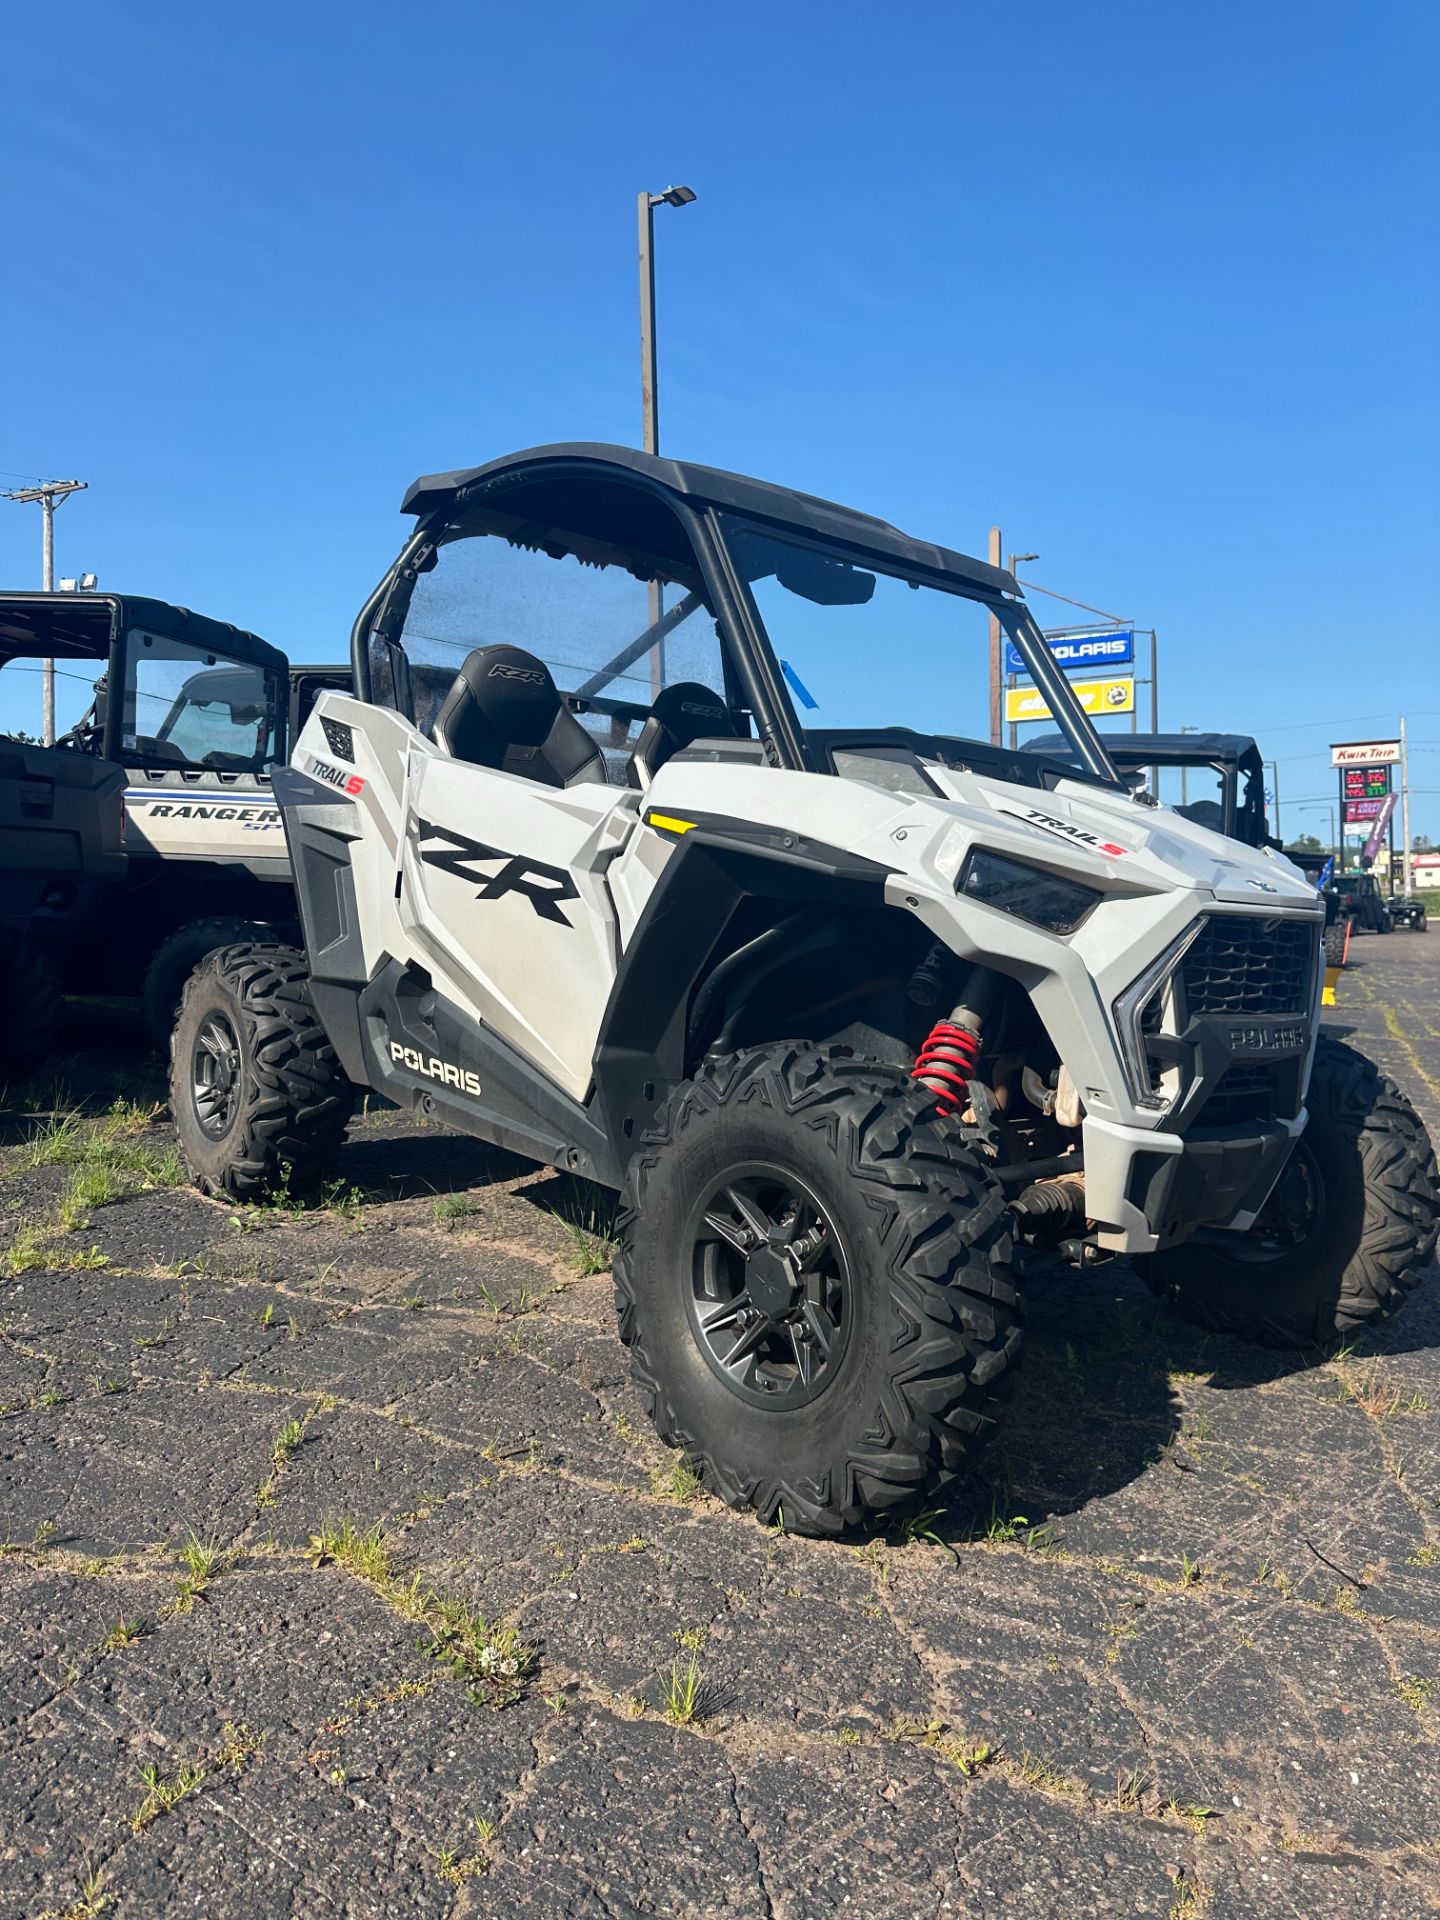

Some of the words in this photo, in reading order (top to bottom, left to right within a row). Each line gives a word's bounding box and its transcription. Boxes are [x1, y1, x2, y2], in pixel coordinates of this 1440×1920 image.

[488, 663, 546, 685] RZR
[1337, 750, 1367, 760] KWIK
[1369, 748, 1395, 758] TRIP
[312, 760, 346, 788] TRAIL
[344, 775, 366, 794] S
[149, 805, 282, 822] RANGER
[1026, 810, 1100, 845] TRAIL
[1098, 843, 1128, 856] S
[1228, 1027, 1304, 1050] POLARIS
[390, 1041, 481, 1096] POLARIS
